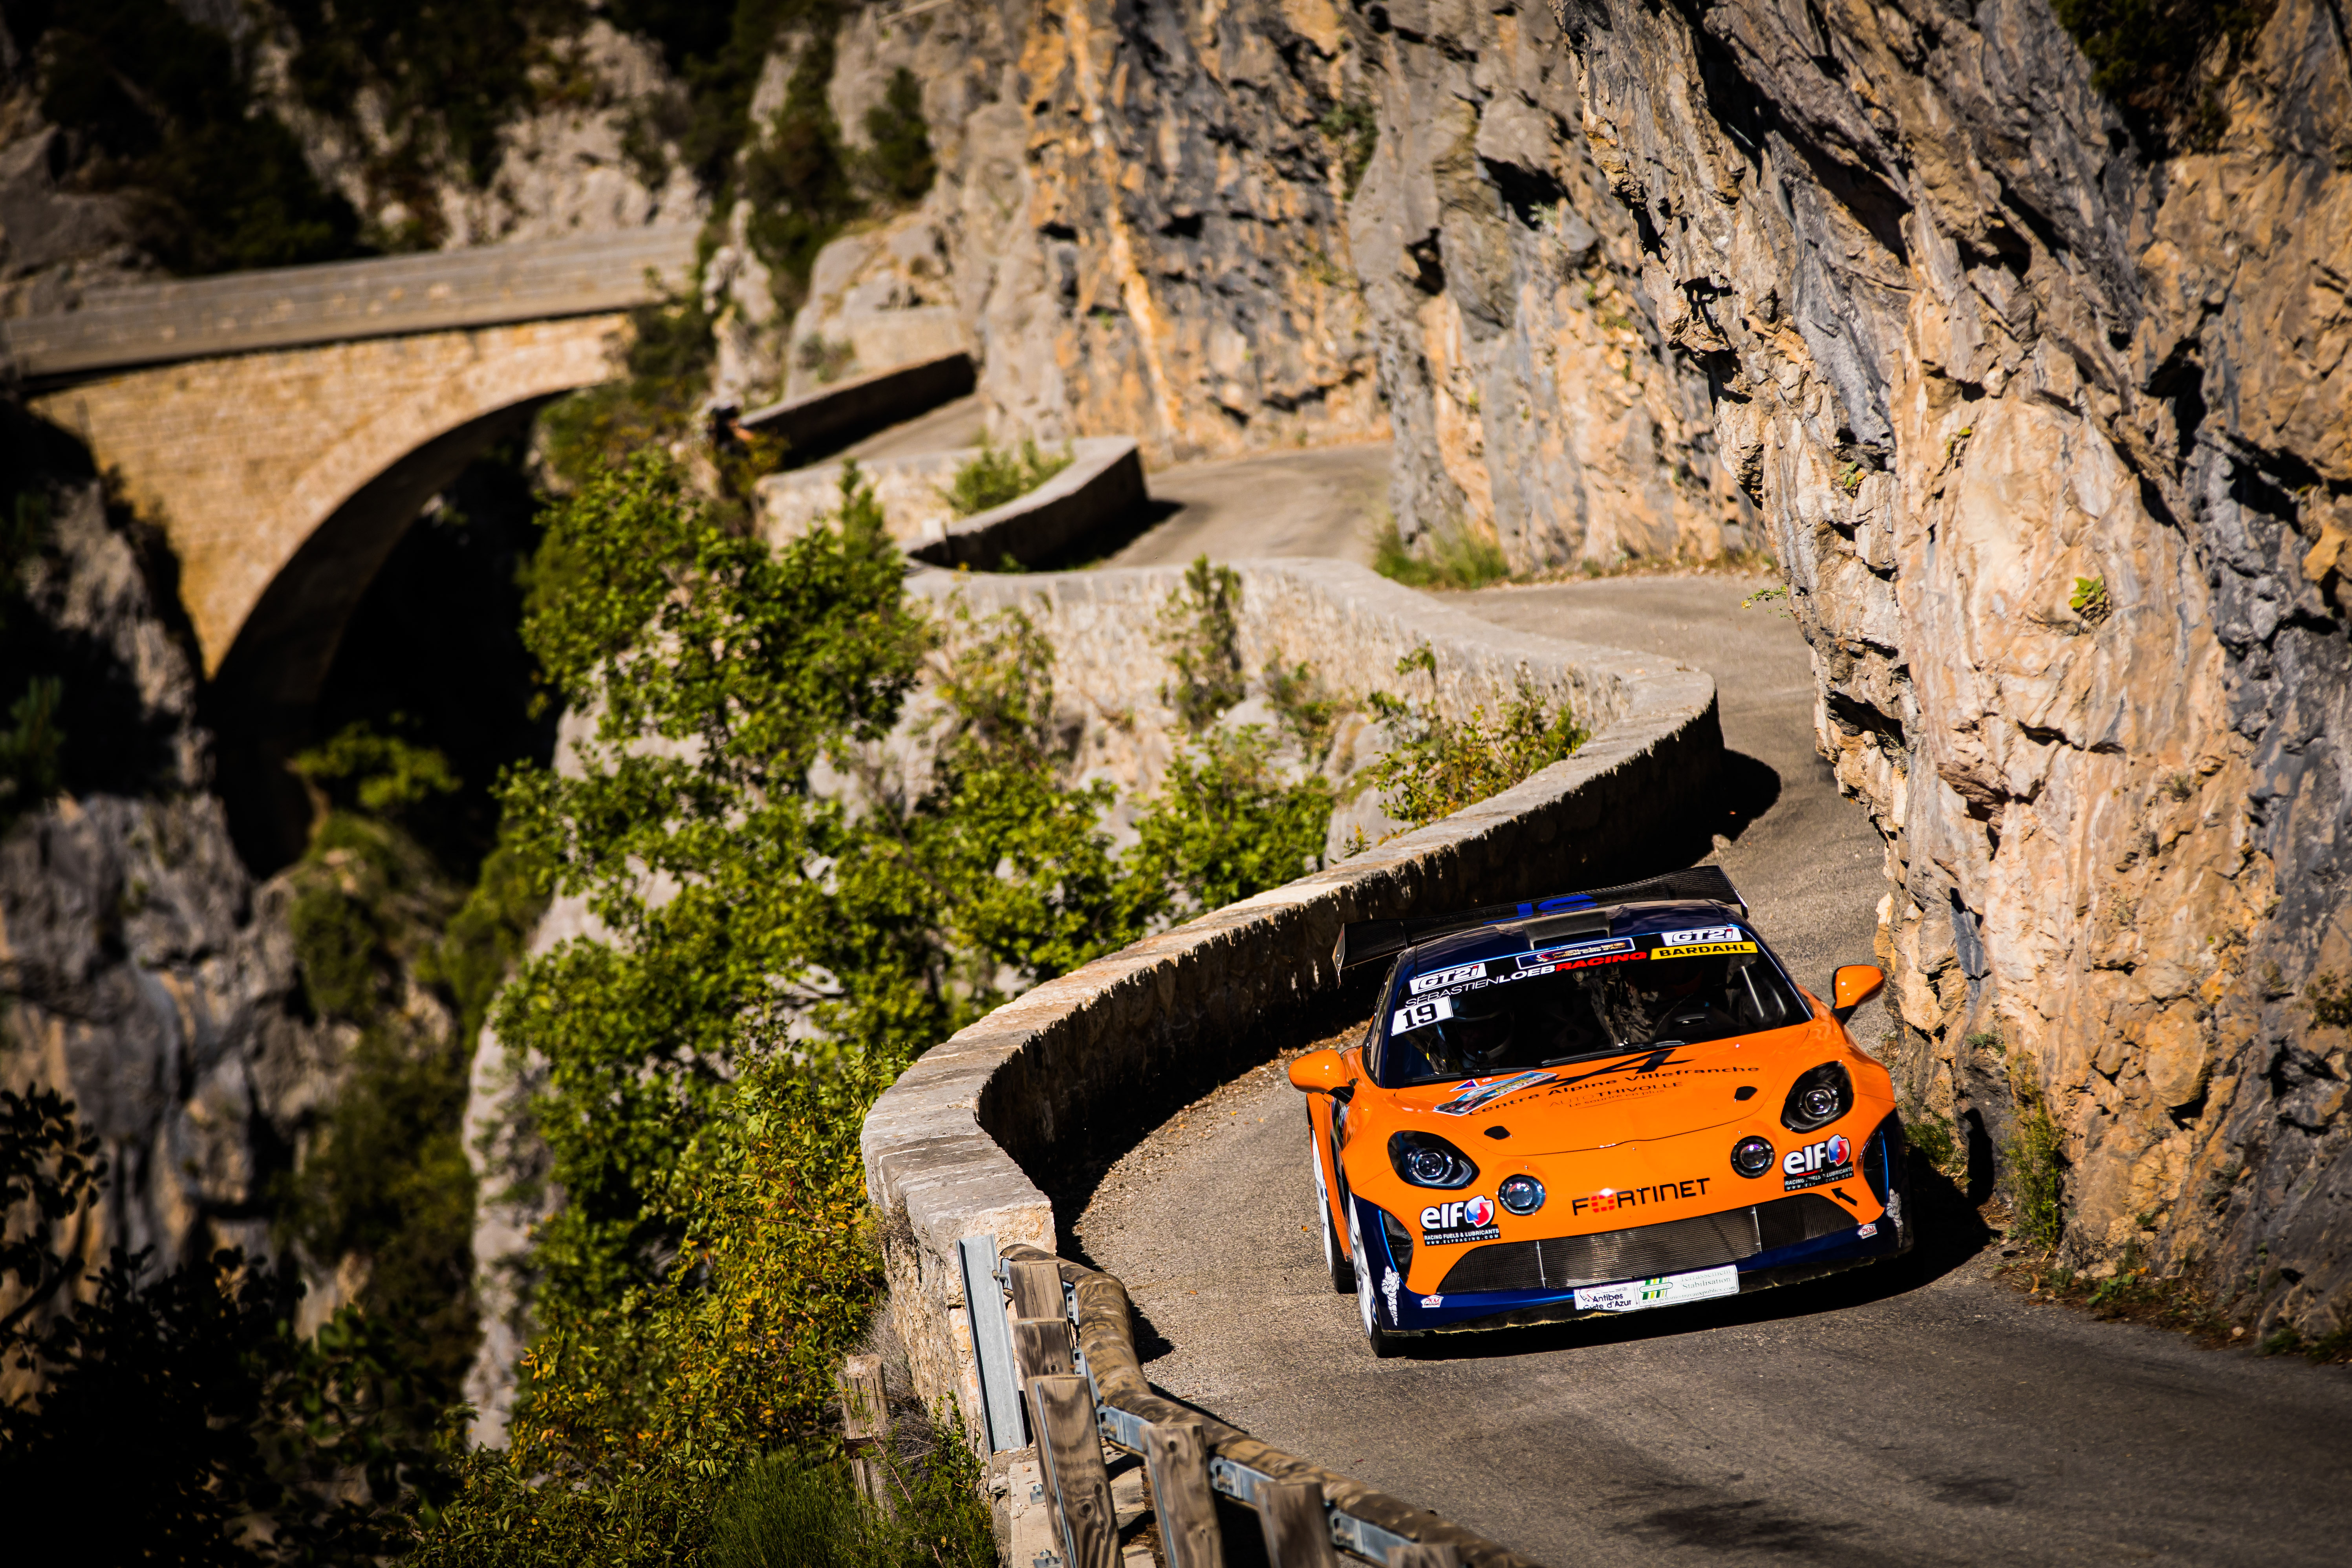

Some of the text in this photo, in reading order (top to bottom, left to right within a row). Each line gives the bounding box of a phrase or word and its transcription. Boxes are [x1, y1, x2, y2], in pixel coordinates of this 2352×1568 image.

[1671, 928, 1733, 942] GT2i
[1659, 944, 1751, 957] BARDAHL
[1418, 964, 1480, 990] GT2i
[1402, 1003, 1438, 1030] 19
[1468, 1067, 1760, 1116] Centre Alpine Villefranche
[1783, 1142, 1826, 1174] elf
[1827, 1166, 1853, 1177] LUBRICANTS
[1572, 1177, 1710, 1216] FORTINET
[1421, 1202, 1464, 1229] elf
[1464, 1228, 1499, 1237] LUBRICANTS
[1862, 1226, 1875, 1234] PKM
[1426, 1234, 1499, 1245] WWW.ELFRACING.COM
[1681, 1269, 1731, 1282] Terrassement
[1682, 1277, 1731, 1290] Stabilisation
[1593, 1293, 1624, 1303] Antibes
[1607, 1299, 1632, 1308] d'Azur
